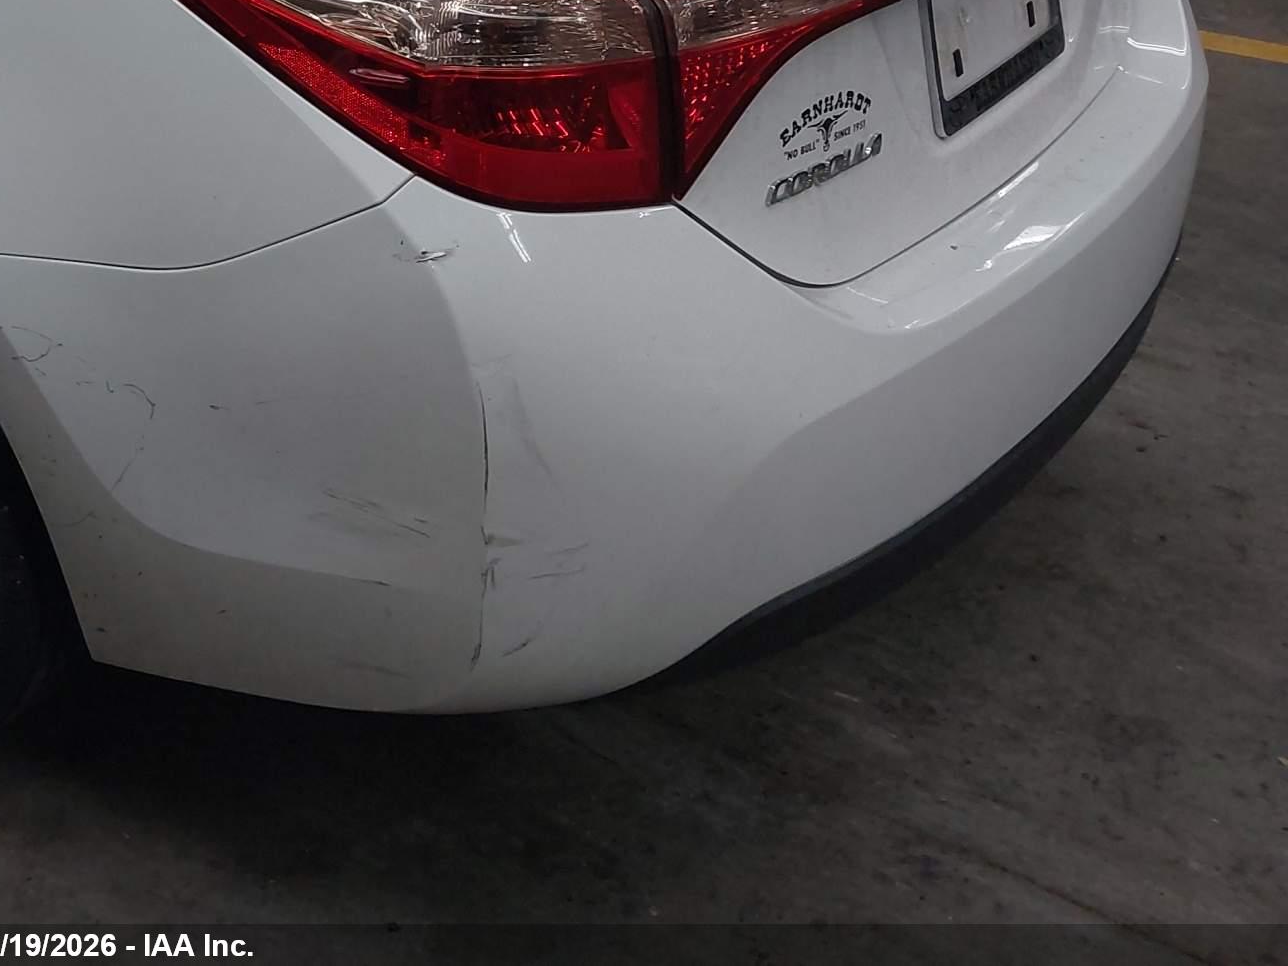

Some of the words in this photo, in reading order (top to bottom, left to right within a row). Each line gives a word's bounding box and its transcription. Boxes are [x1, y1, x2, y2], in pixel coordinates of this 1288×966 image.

[779, 90, 872, 148] EARNHARDT
[833, 126, 851, 142] SINCE
[765, 133, 883, 207] COROLLA
